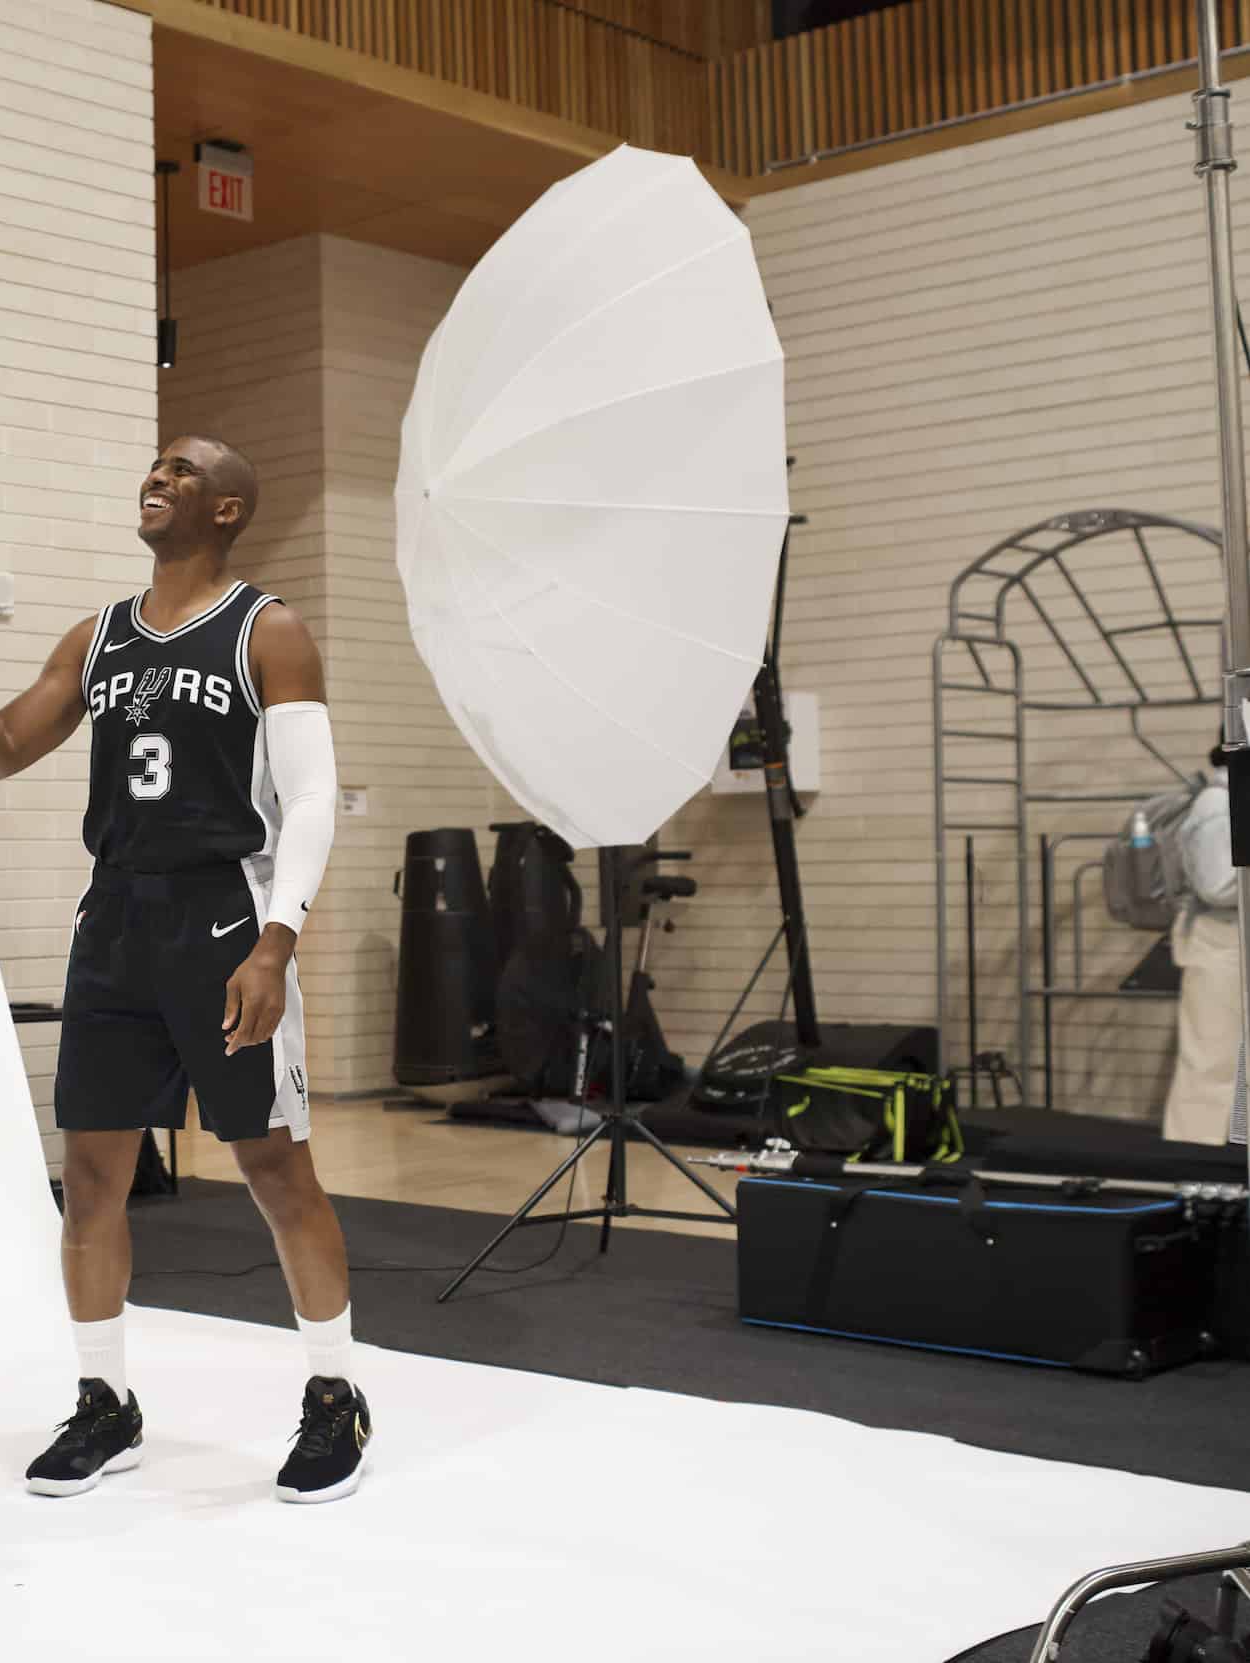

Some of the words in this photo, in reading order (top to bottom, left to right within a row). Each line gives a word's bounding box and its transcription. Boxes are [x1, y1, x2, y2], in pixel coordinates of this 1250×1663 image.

[209, 169, 244, 213] EXIT
[90, 667, 232, 726] SPURS
[128, 733, 173, 801] 3
